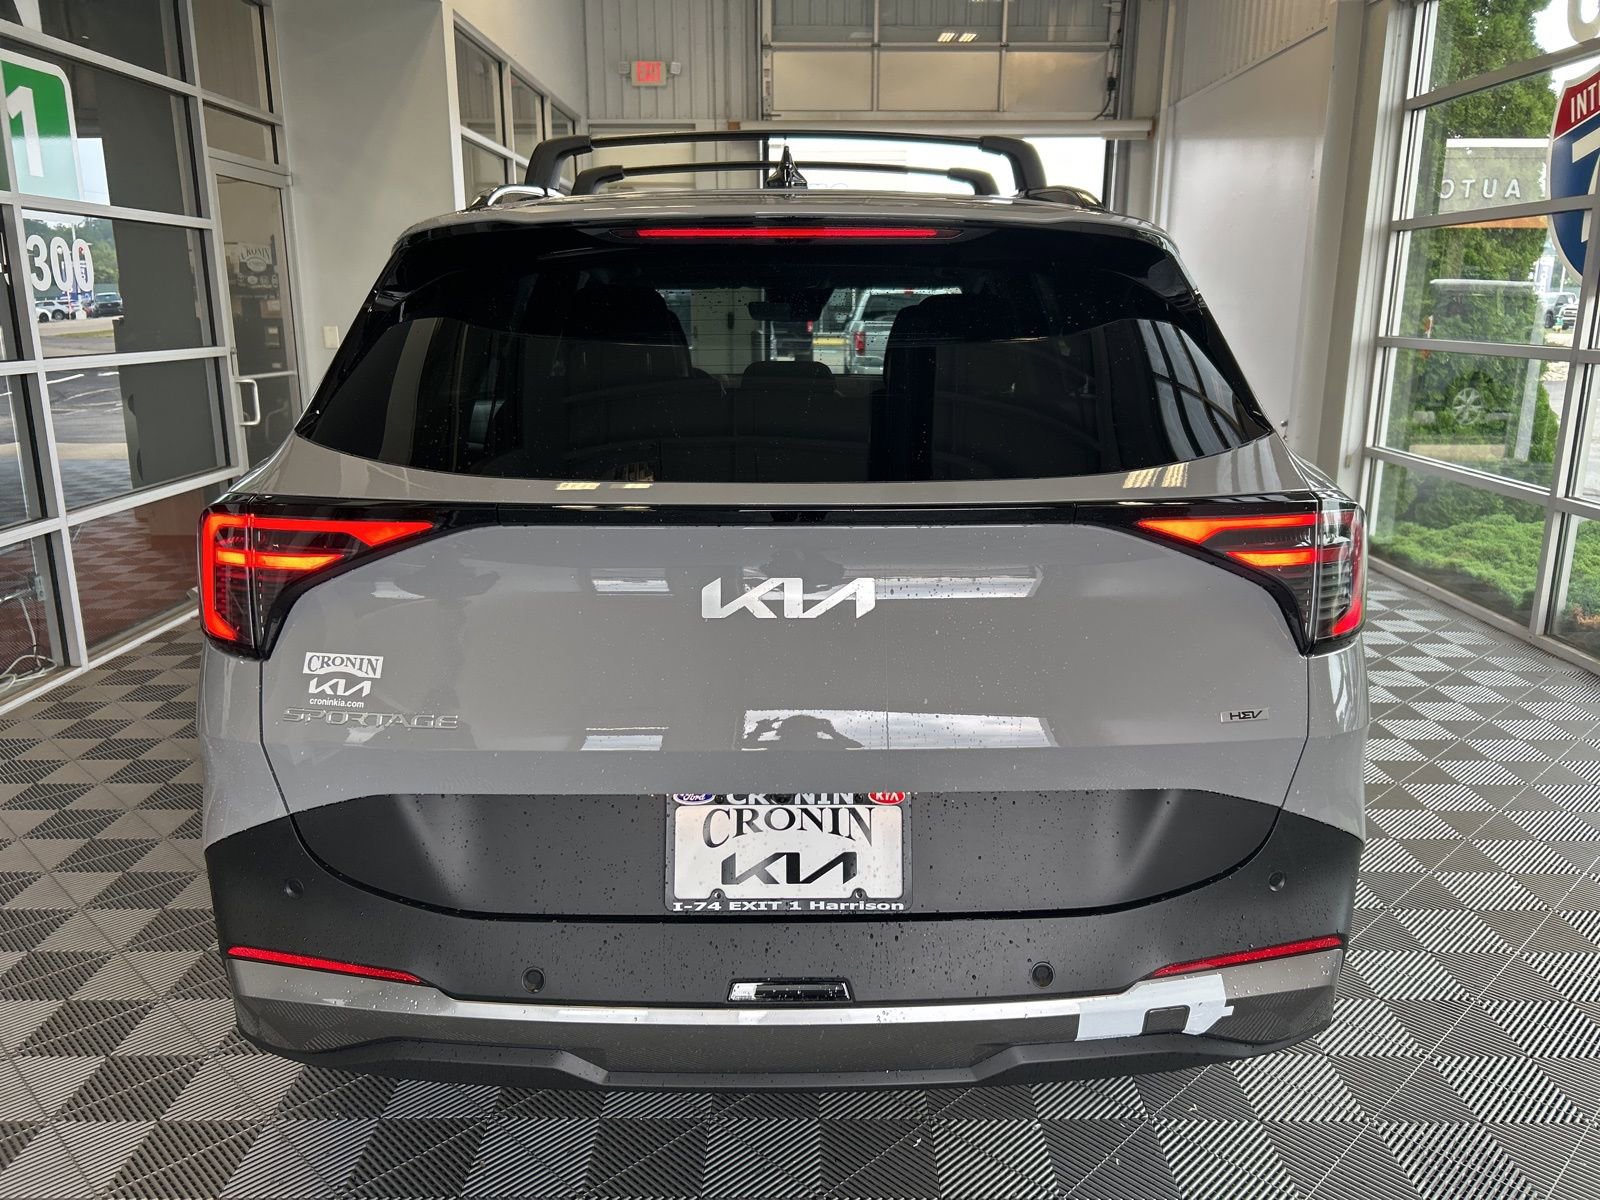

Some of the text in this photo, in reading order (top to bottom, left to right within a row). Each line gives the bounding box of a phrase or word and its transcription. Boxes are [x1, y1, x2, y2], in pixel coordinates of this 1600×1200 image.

[636, 61, 661, 81] EXIT
[1571, 79, 1600, 123] INT
[702, 577, 876, 619] KIA
[307, 654, 380, 677] CRONIN
[308, 676, 372, 697] KIA
[309, 697, 365, 708] croninkia.com
[283, 707, 459, 729] SPORTAGE
[1229, 710, 1263, 720] HEV
[726, 793, 854, 805] CRNIN
[875, 792, 900, 801] KIA
[702, 806, 876, 849] CRONIN
[721, 851, 858, 885] KIA
[672, 900, 905, 912] I-74 EXIT 1 Harrison
